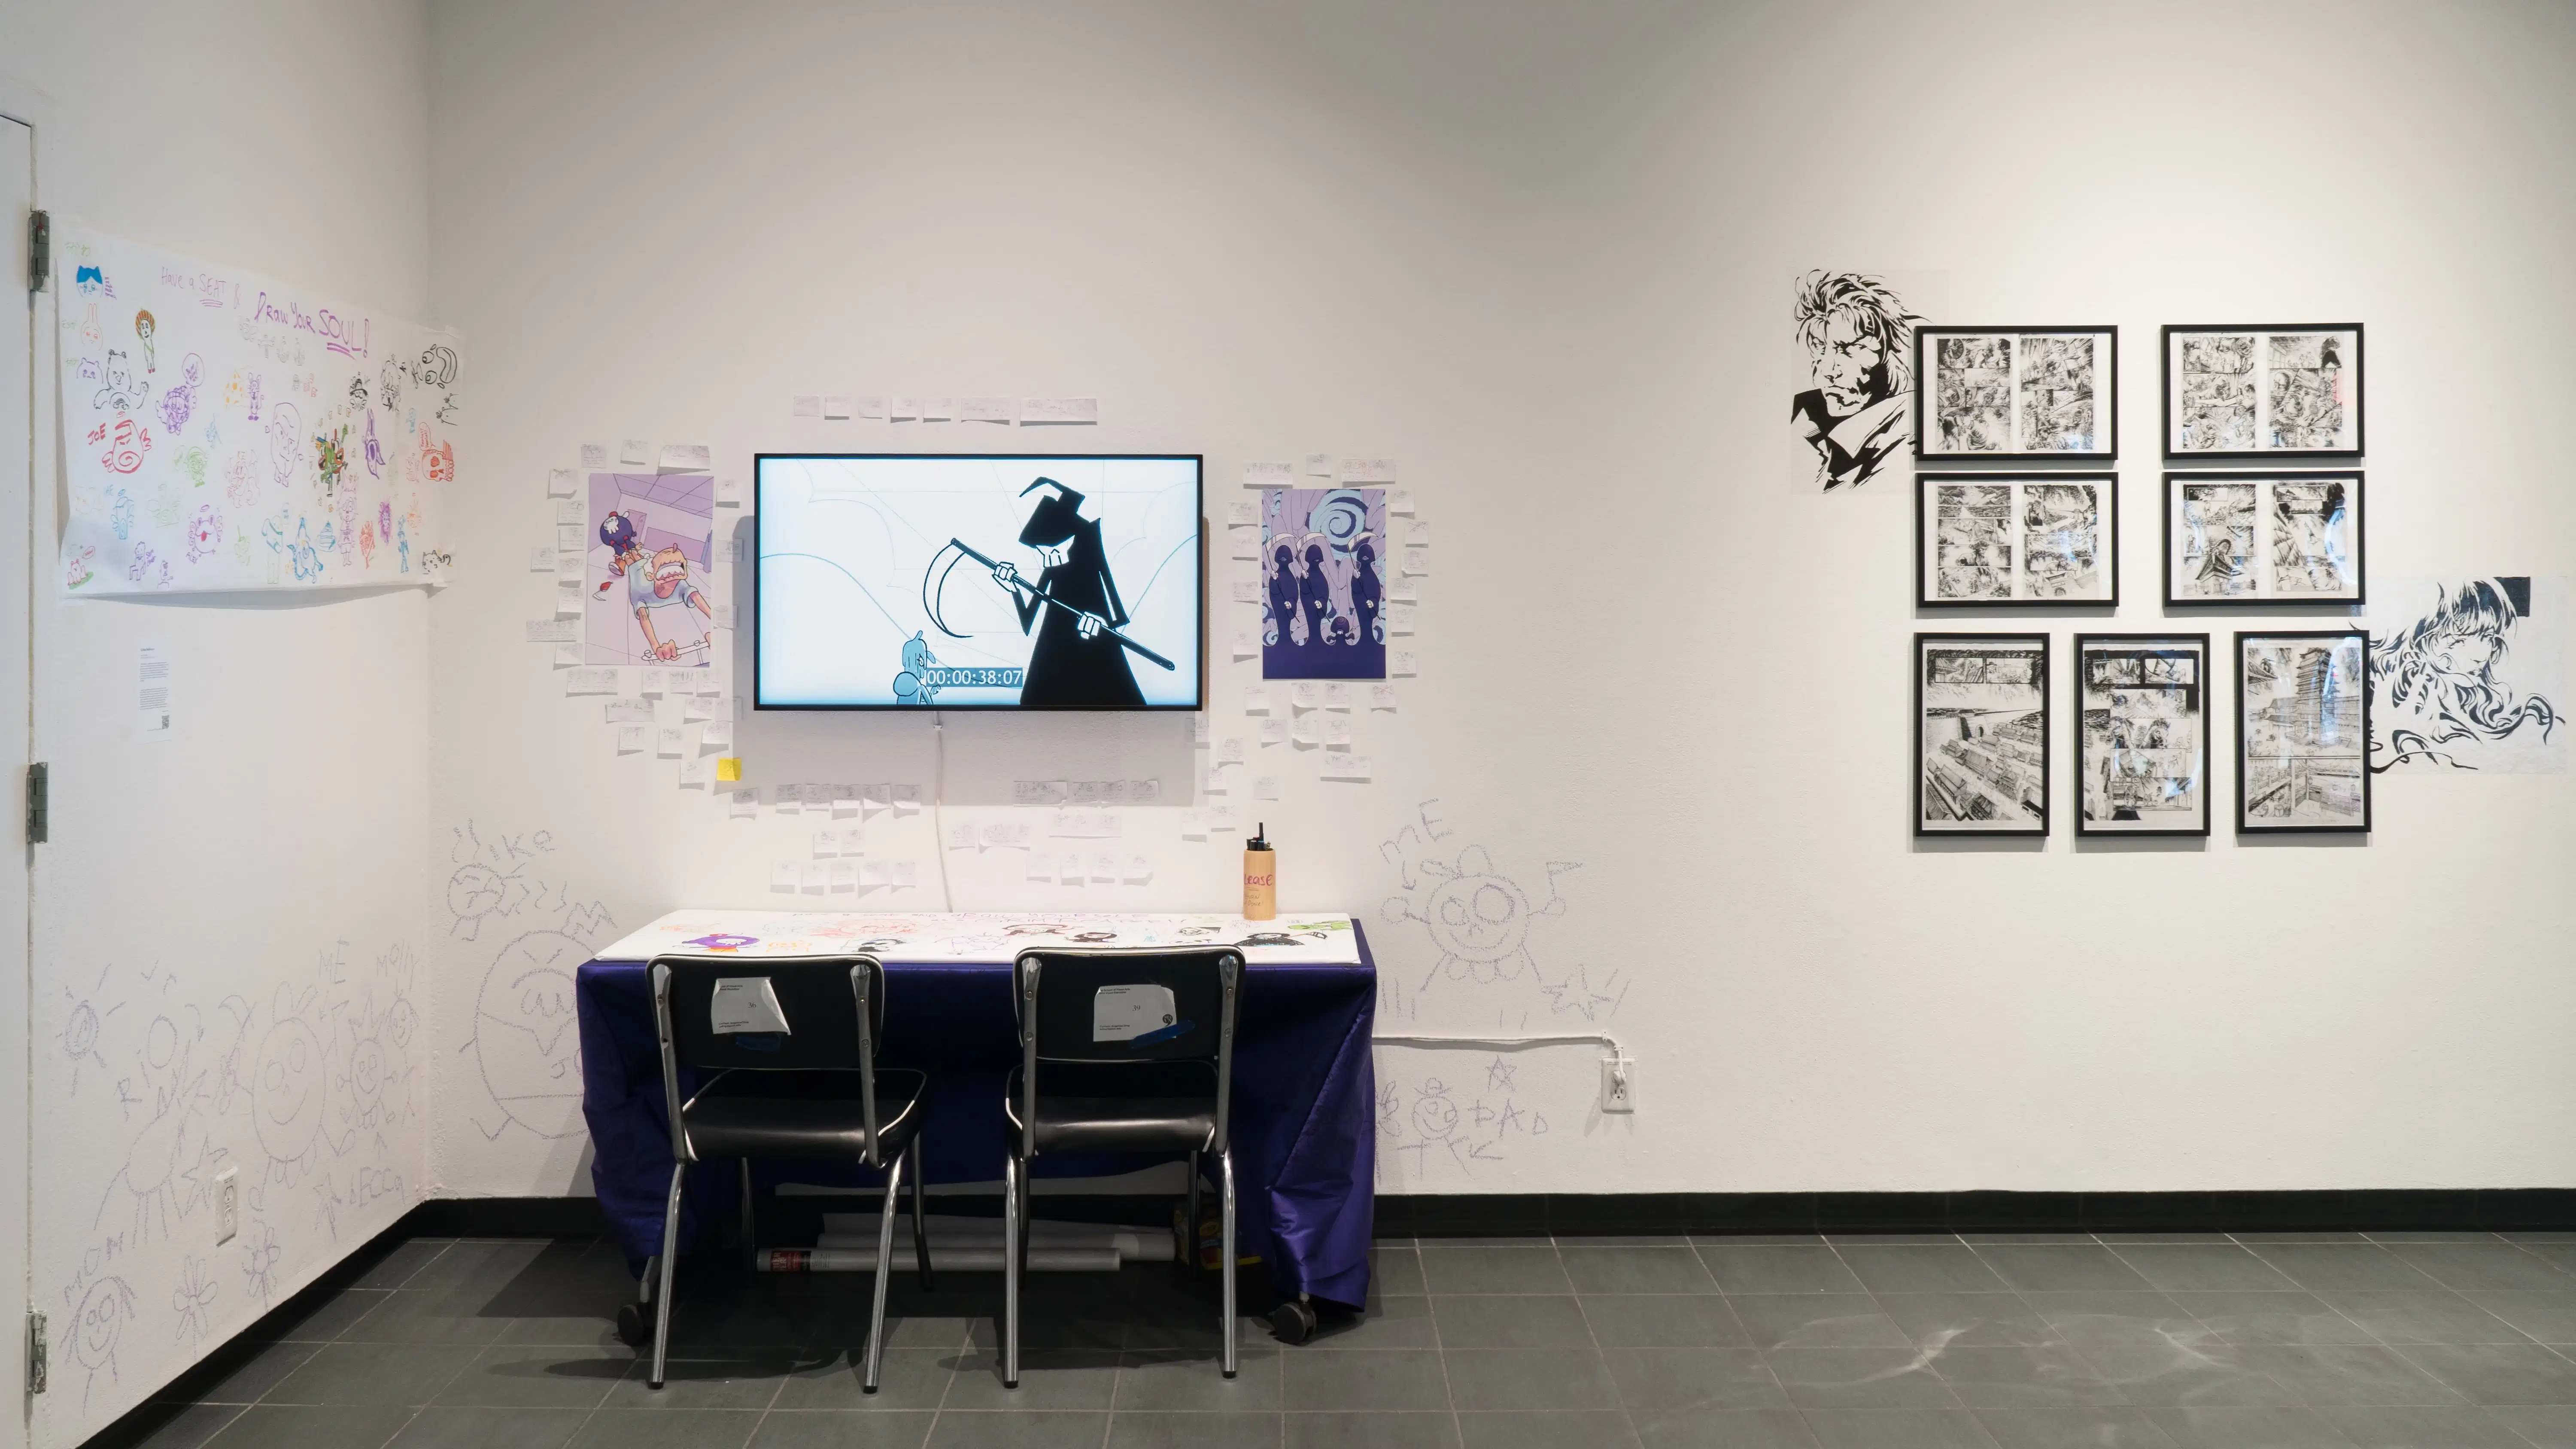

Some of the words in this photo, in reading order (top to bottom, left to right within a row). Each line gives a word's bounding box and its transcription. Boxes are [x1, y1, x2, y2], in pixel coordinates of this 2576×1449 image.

[199, 273, 227, 298] SEAT
[87, 422, 106, 445] JOE
[927, 670, 1023, 685] 00:00:38:07
[1467, 1098, 1549, 1140] DAD
